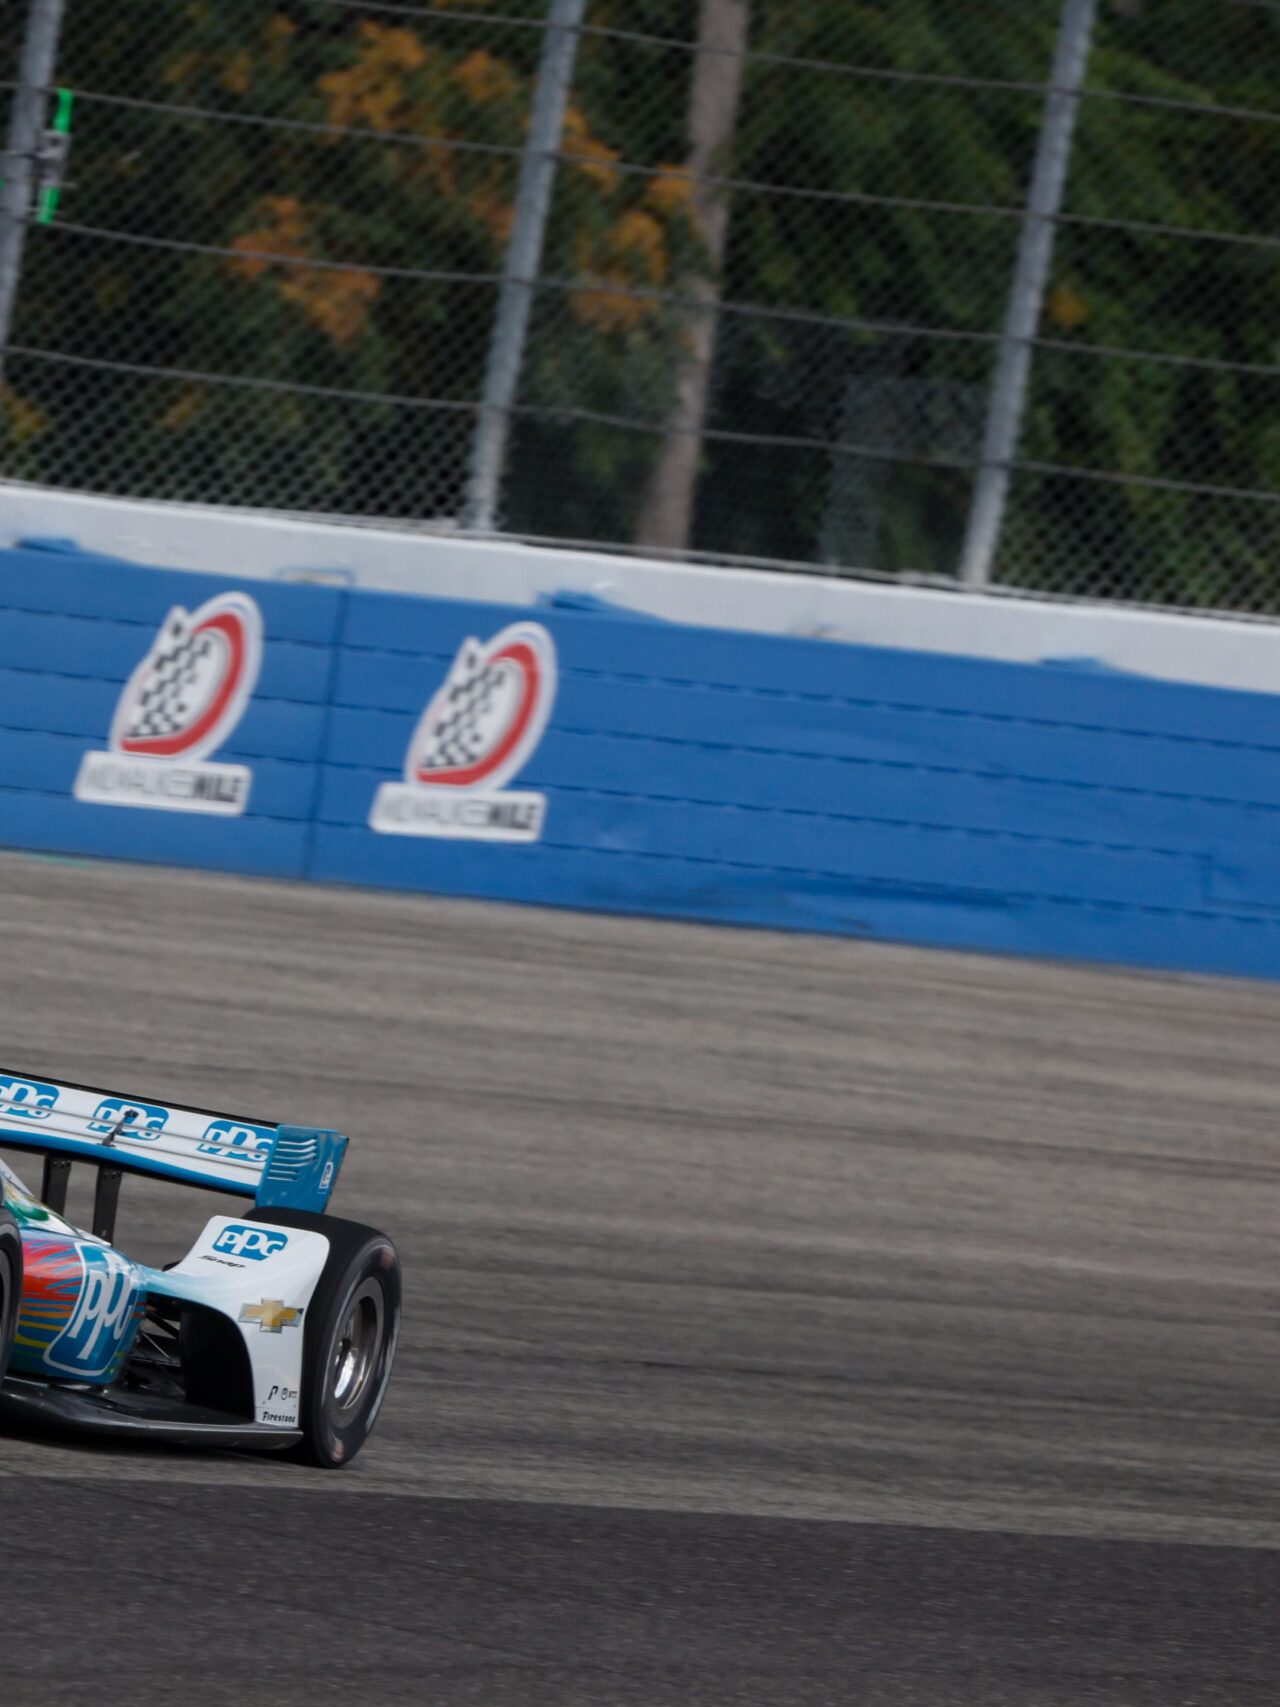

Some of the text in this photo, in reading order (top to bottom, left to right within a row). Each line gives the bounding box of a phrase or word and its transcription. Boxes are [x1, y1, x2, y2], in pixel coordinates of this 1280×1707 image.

[91, 1105, 165, 1138] PPG
[198, 1127, 273, 1161] PPG
[216, 1229, 284, 1257] PPG
[262, 1411, 296, 1423] Firestone
